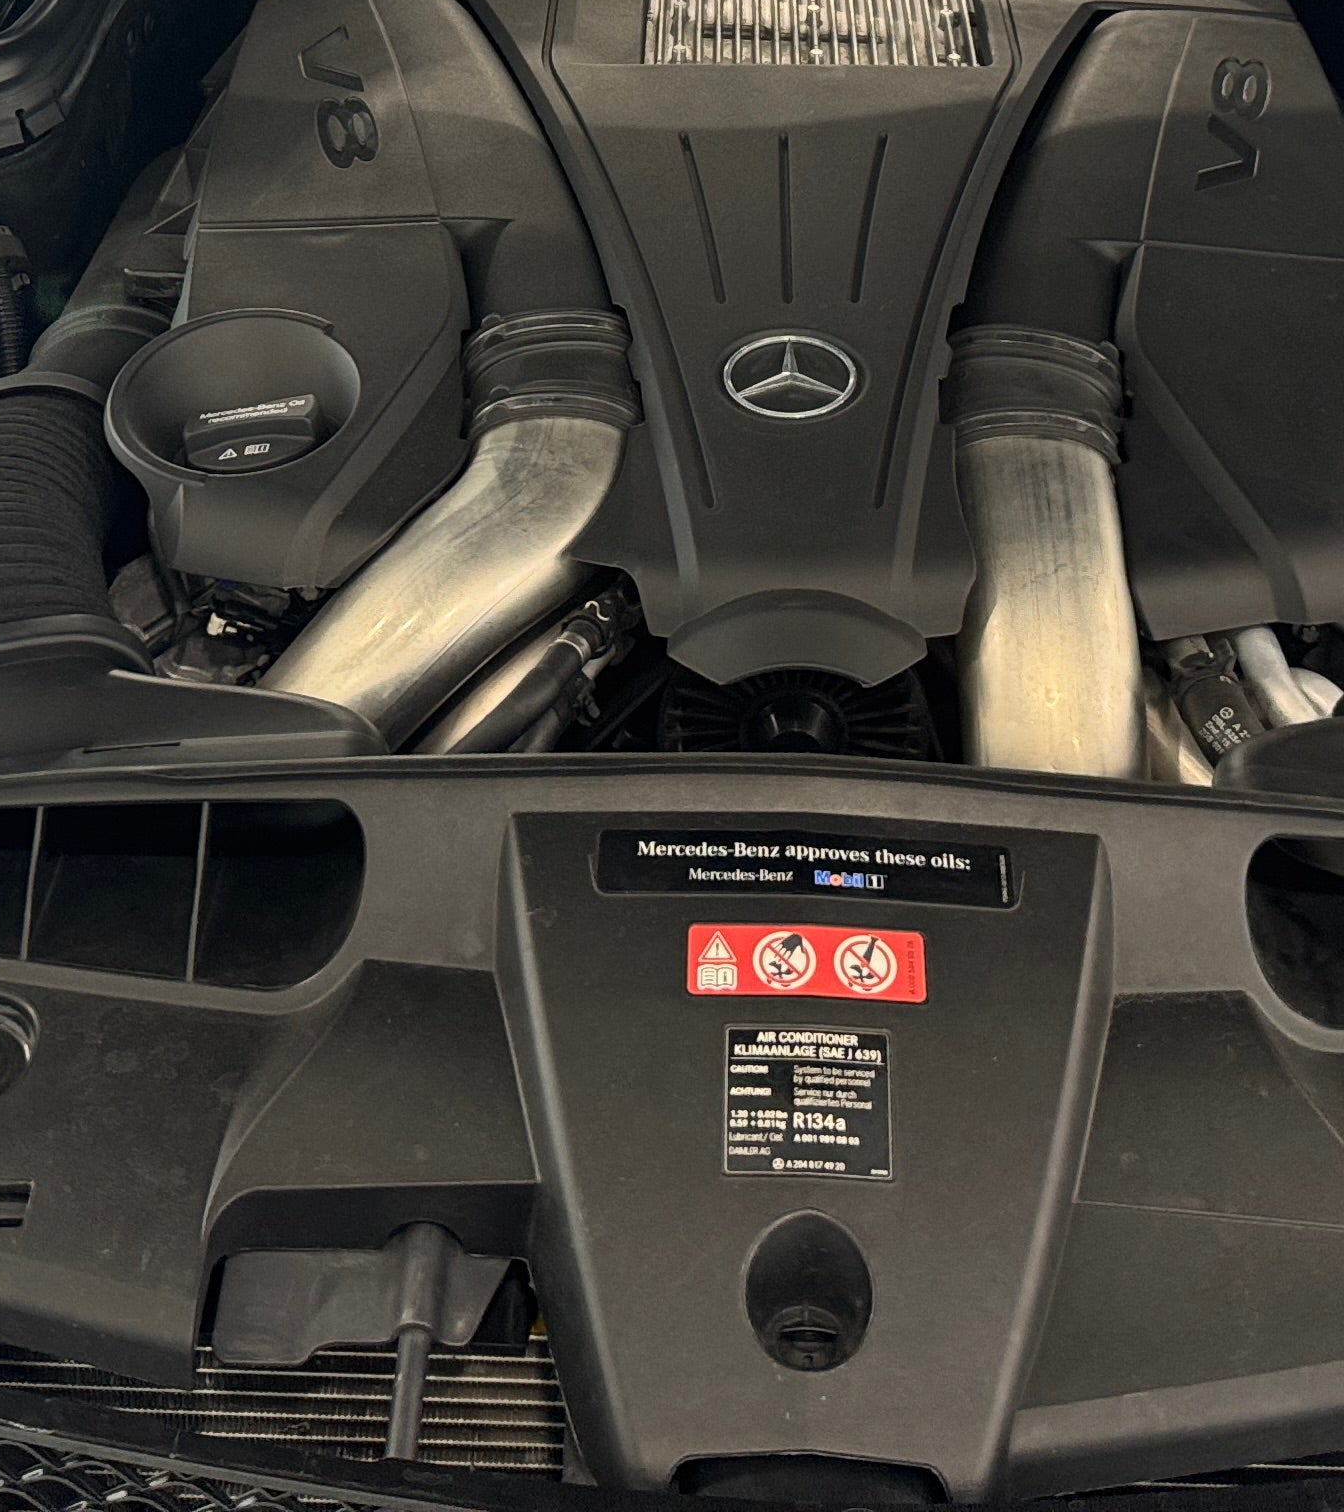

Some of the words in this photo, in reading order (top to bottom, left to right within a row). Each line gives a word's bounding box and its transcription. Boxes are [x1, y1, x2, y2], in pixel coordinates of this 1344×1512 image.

[297, 24, 381, 169] V8
[1194, 56, 1273, 192] V8
[199, 402, 287, 419] Mercedes-Benz
[208, 407, 288, 424] recommended
[636, 840, 781, 858] Mercedes-Benz
[784, 844, 870, 864] approves
[874, 848, 927, 867] these
[930, 852, 972, 871] oils:
[688, 867, 794, 882] Mercedes-Benz
[814, 869, 864, 888] Mobil
[756, 1031, 777, 1043] AIR
[778, 1032, 859, 1046] CONDITIONER
[733, 1044, 816, 1057] KLIMAANLAGE
[819, 1046, 846, 1060] (SAE
[847, 1049, 852, 1060] J
[854, 1048, 882, 1064] 639)
[792, 1112, 847, 1131] R134a
